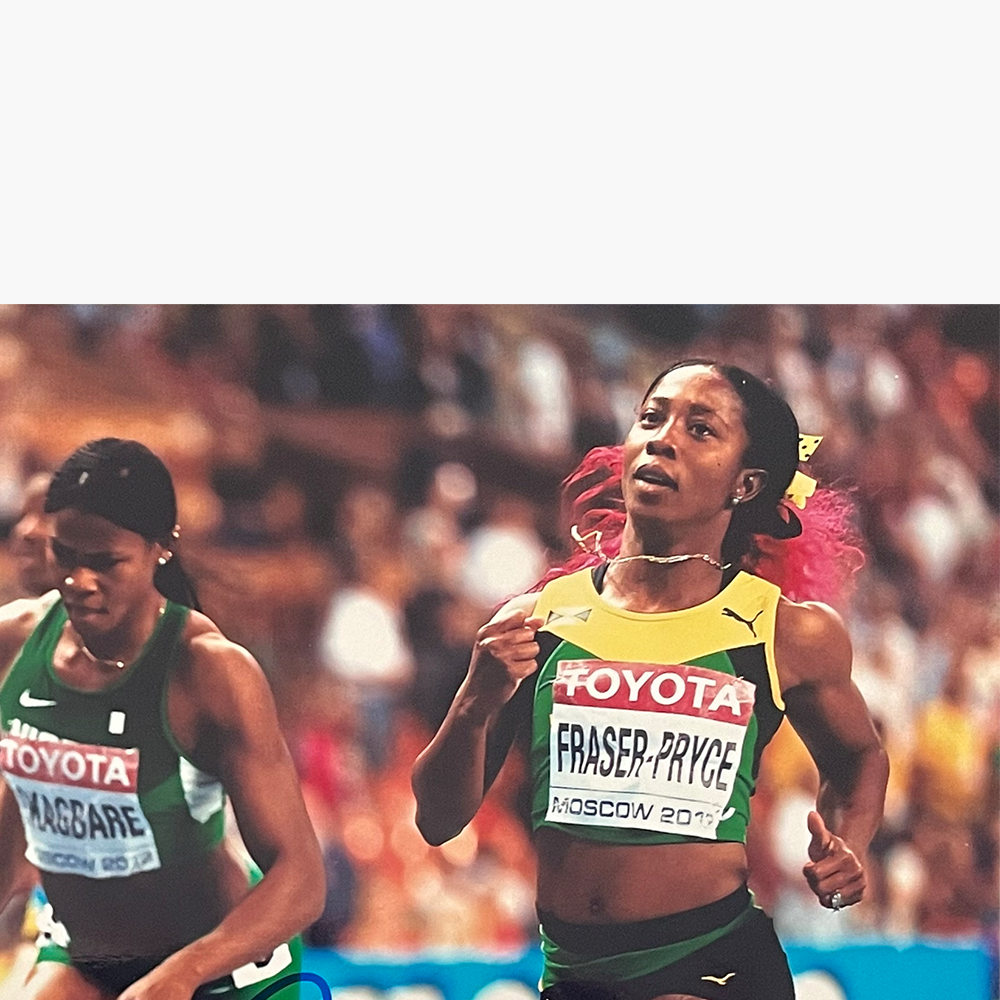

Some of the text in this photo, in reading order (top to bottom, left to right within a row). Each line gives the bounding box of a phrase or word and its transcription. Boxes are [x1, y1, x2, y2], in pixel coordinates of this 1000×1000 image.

[561, 667, 742, 716] TOYOTA
[0, 738, 130, 786] TOYOTA
[557, 722, 737, 791] FRASER-PRYCE
[551, 796, 654, 820] MOSCOW
